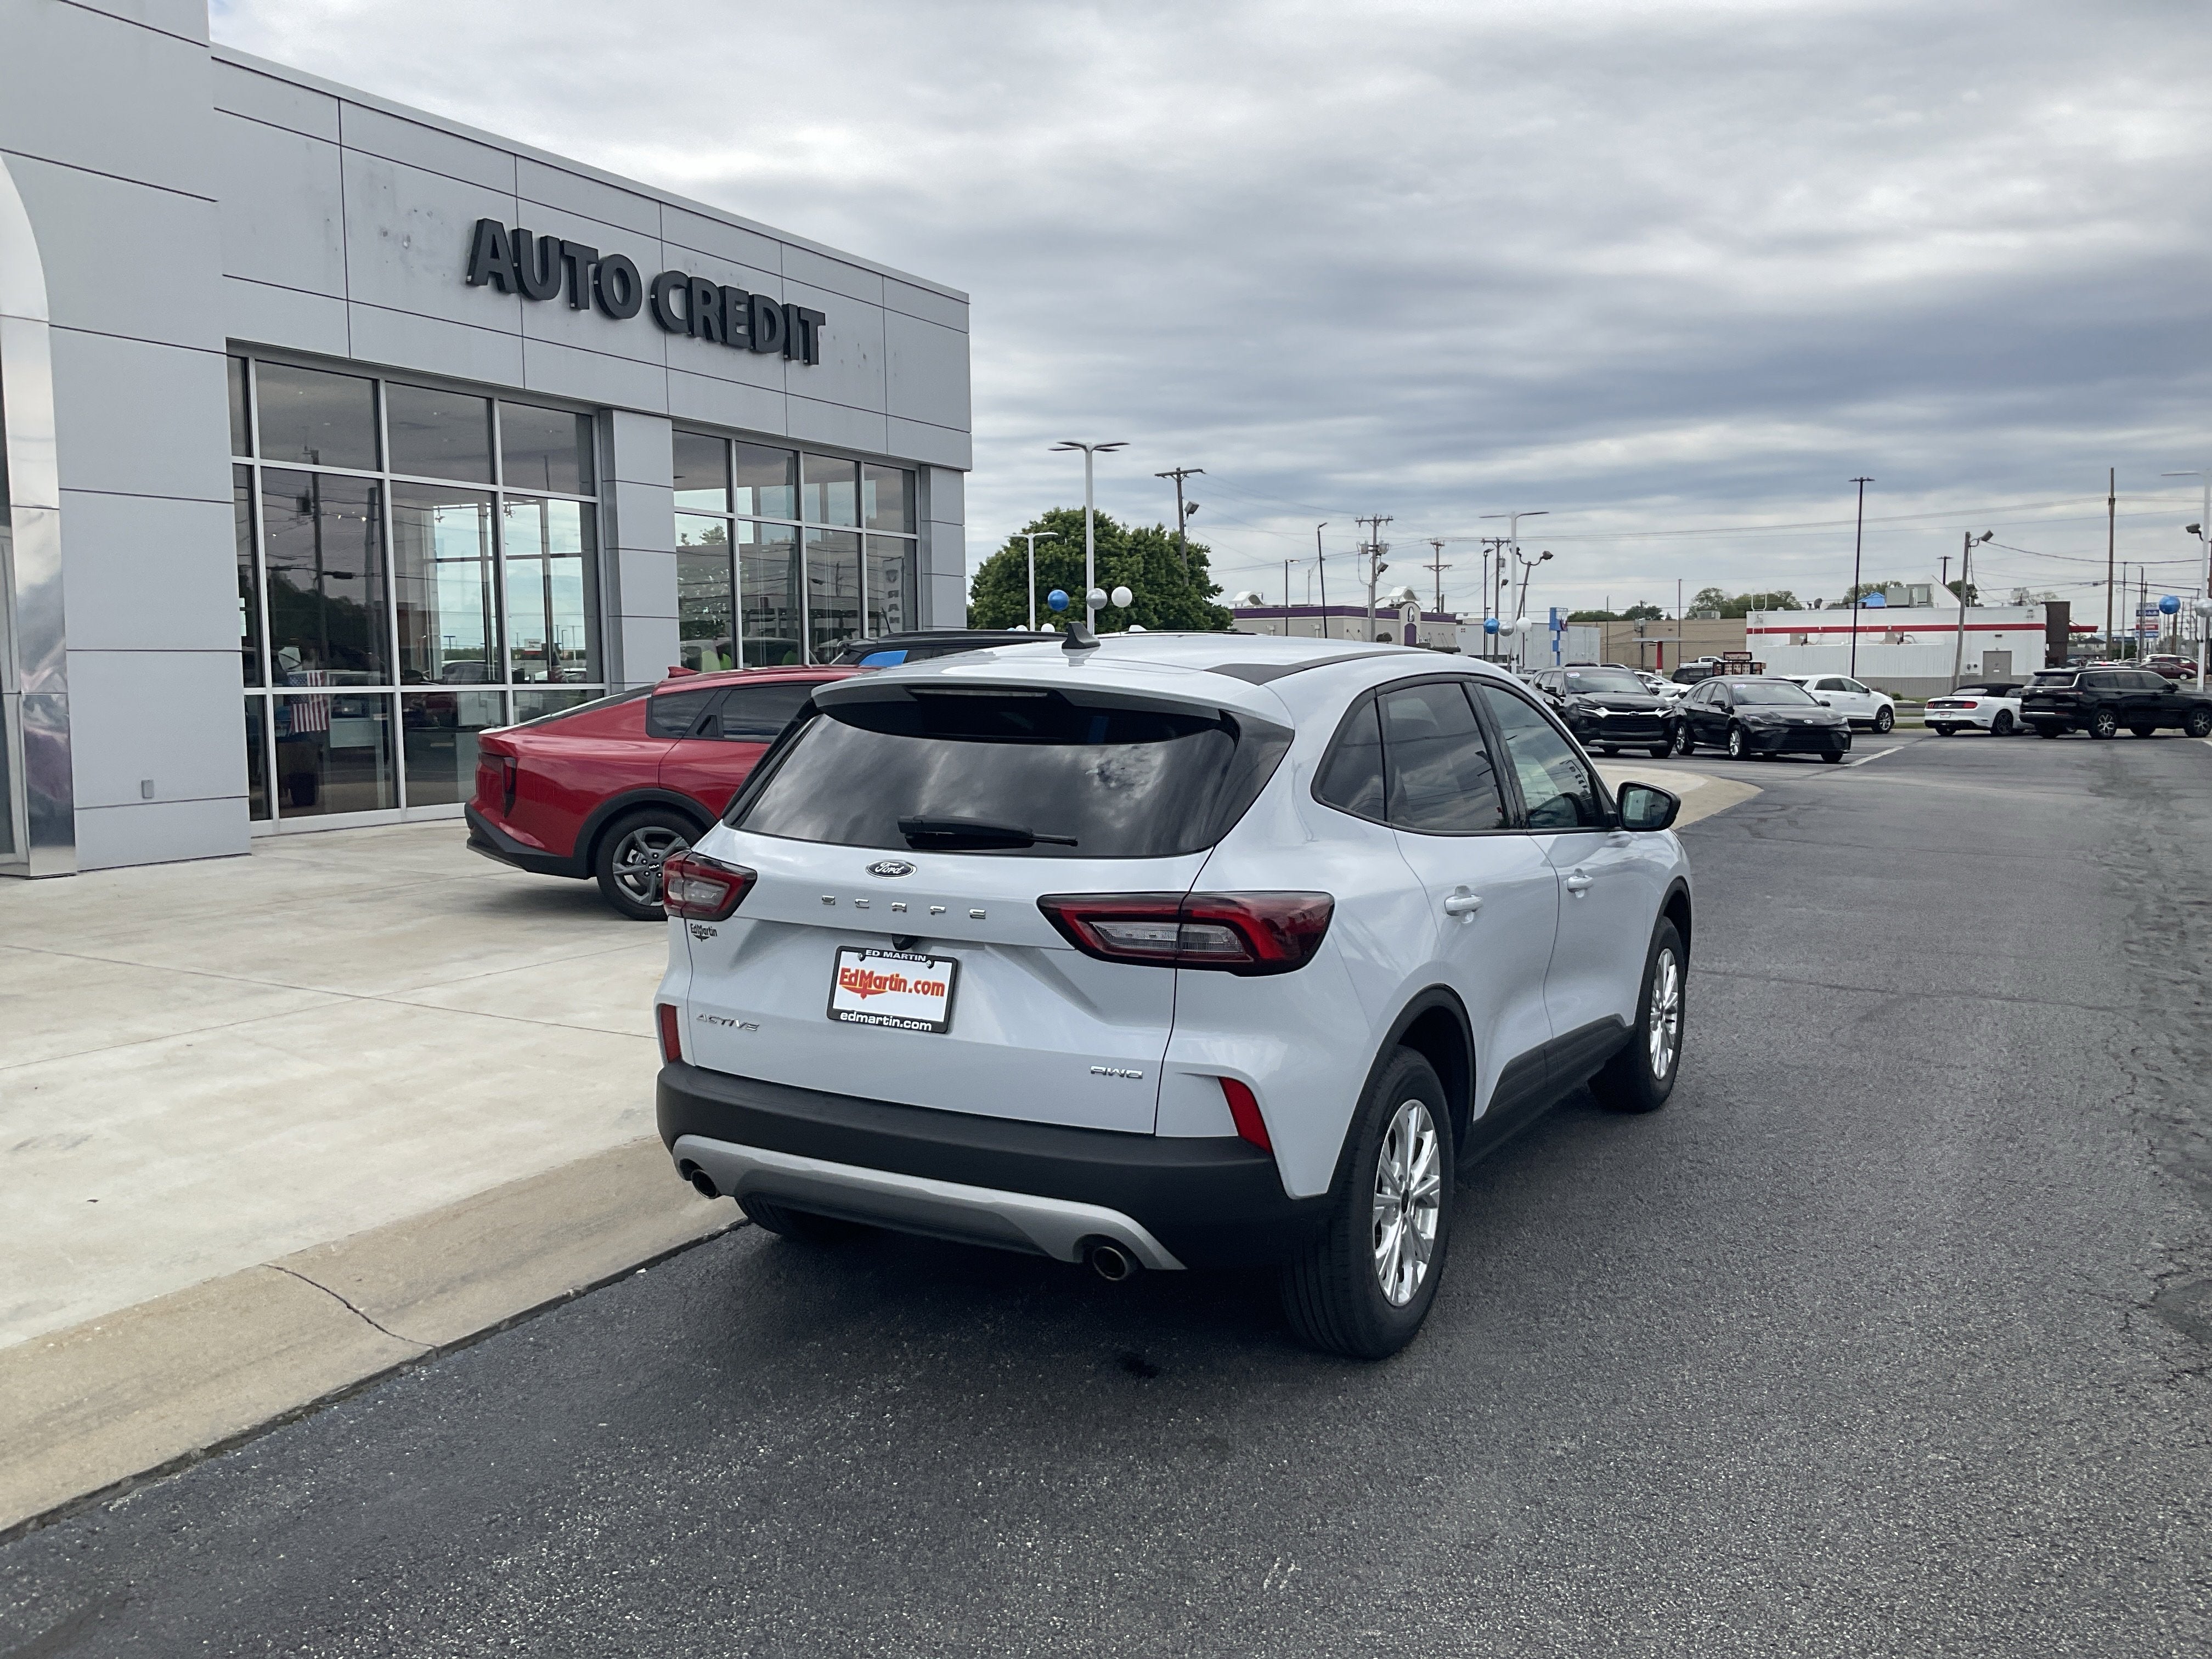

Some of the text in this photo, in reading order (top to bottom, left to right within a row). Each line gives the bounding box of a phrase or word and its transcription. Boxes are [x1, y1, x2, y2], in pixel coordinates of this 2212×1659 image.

[466, 218, 826, 365] AUTO CREDIT
[875, 862, 905, 874] Ford
[883, 951, 926, 961] MARTIN
[839, 967, 945, 997] EdMartin.com
[696, 1014, 759, 1031] ACTIVE
[840, 1012, 932, 1031] edmartin.com
[1091, 1065, 1143, 1079] AWD
